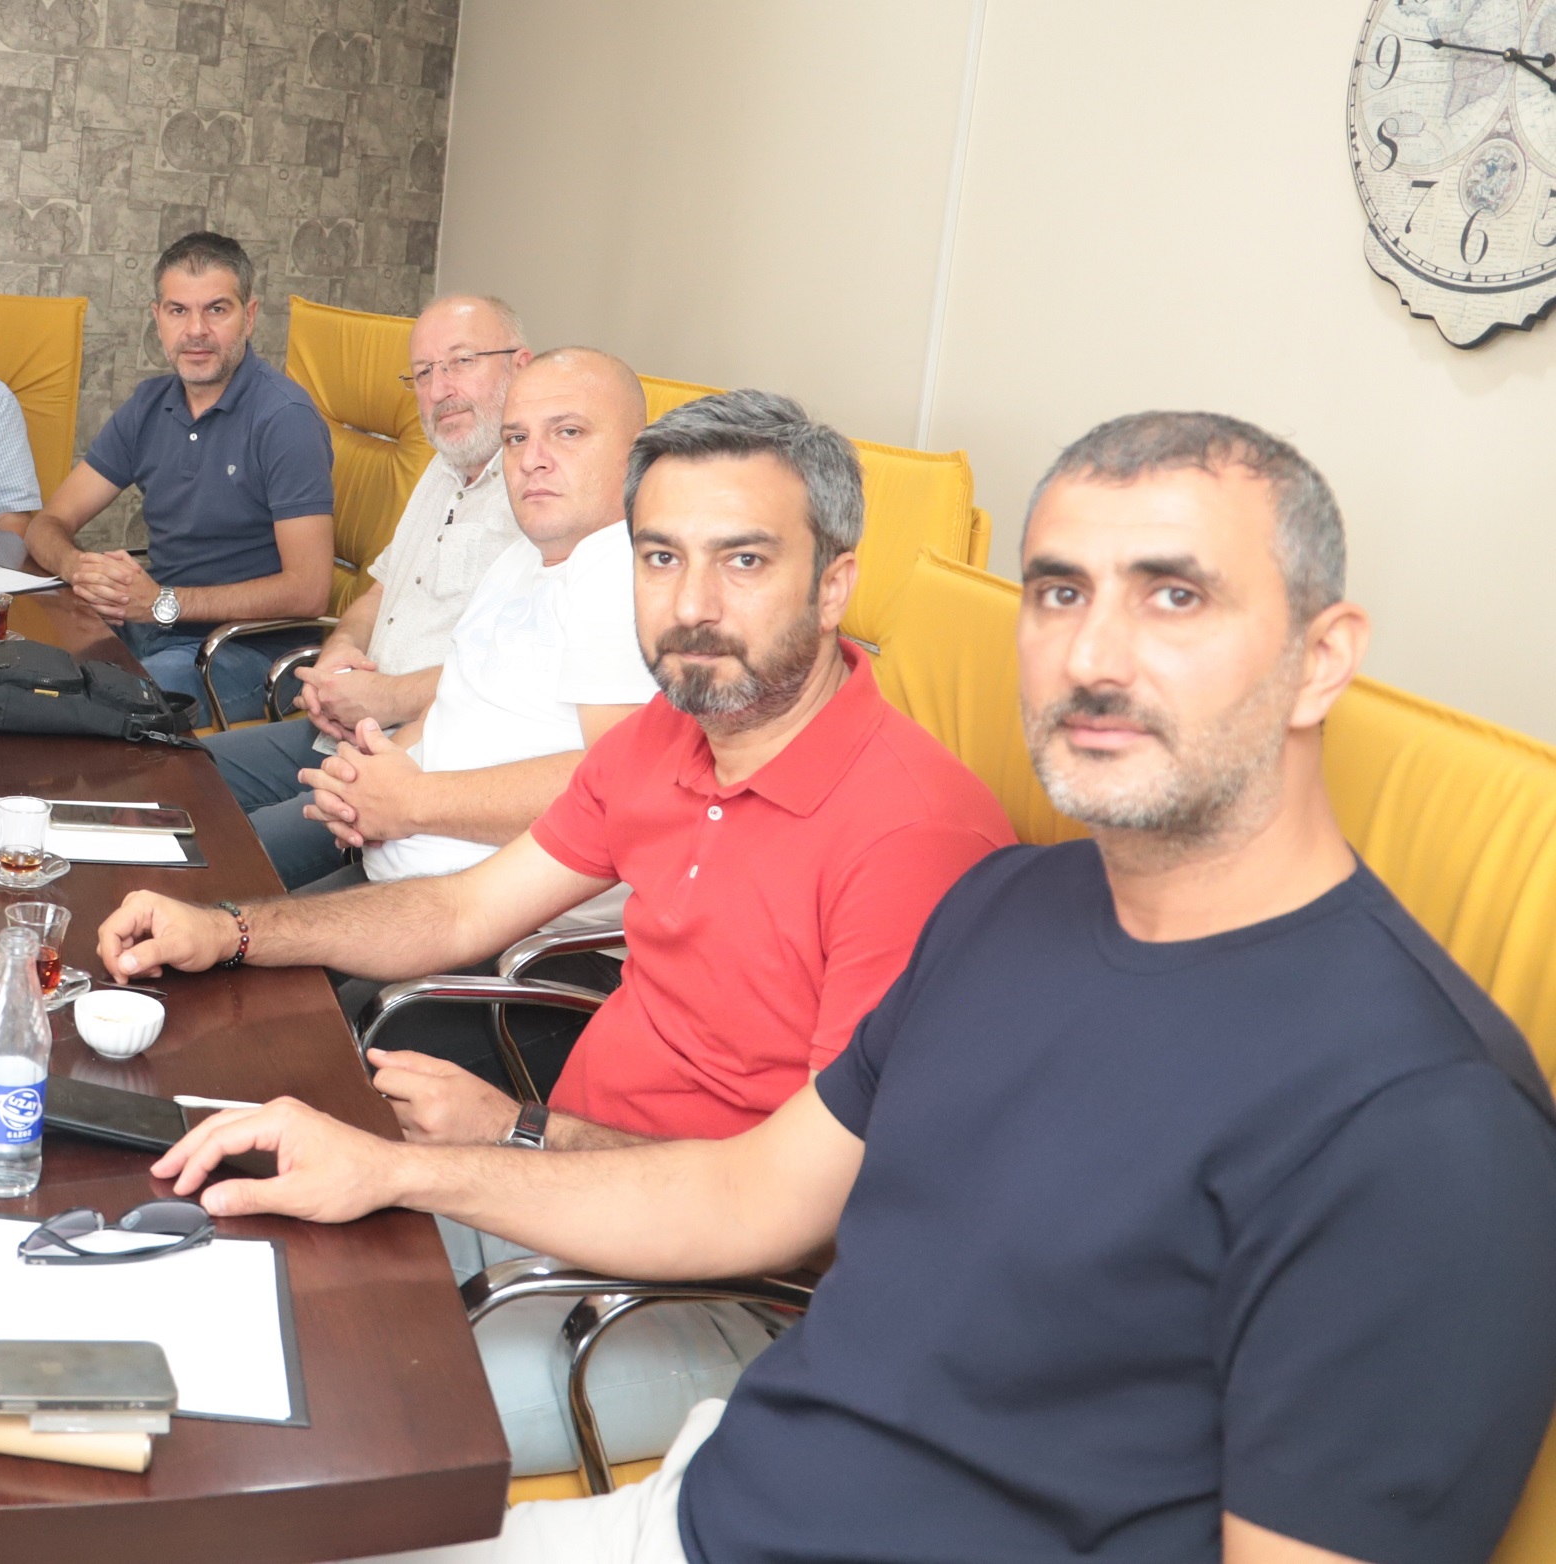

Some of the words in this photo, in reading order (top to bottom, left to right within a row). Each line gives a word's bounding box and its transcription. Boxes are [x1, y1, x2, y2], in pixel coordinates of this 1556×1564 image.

[1369, 34, 1401, 90] 9
[1370, 117, 1399, 172] 8
[1405, 180, 1439, 234] 7
[1460, 207, 1489, 265] 6
